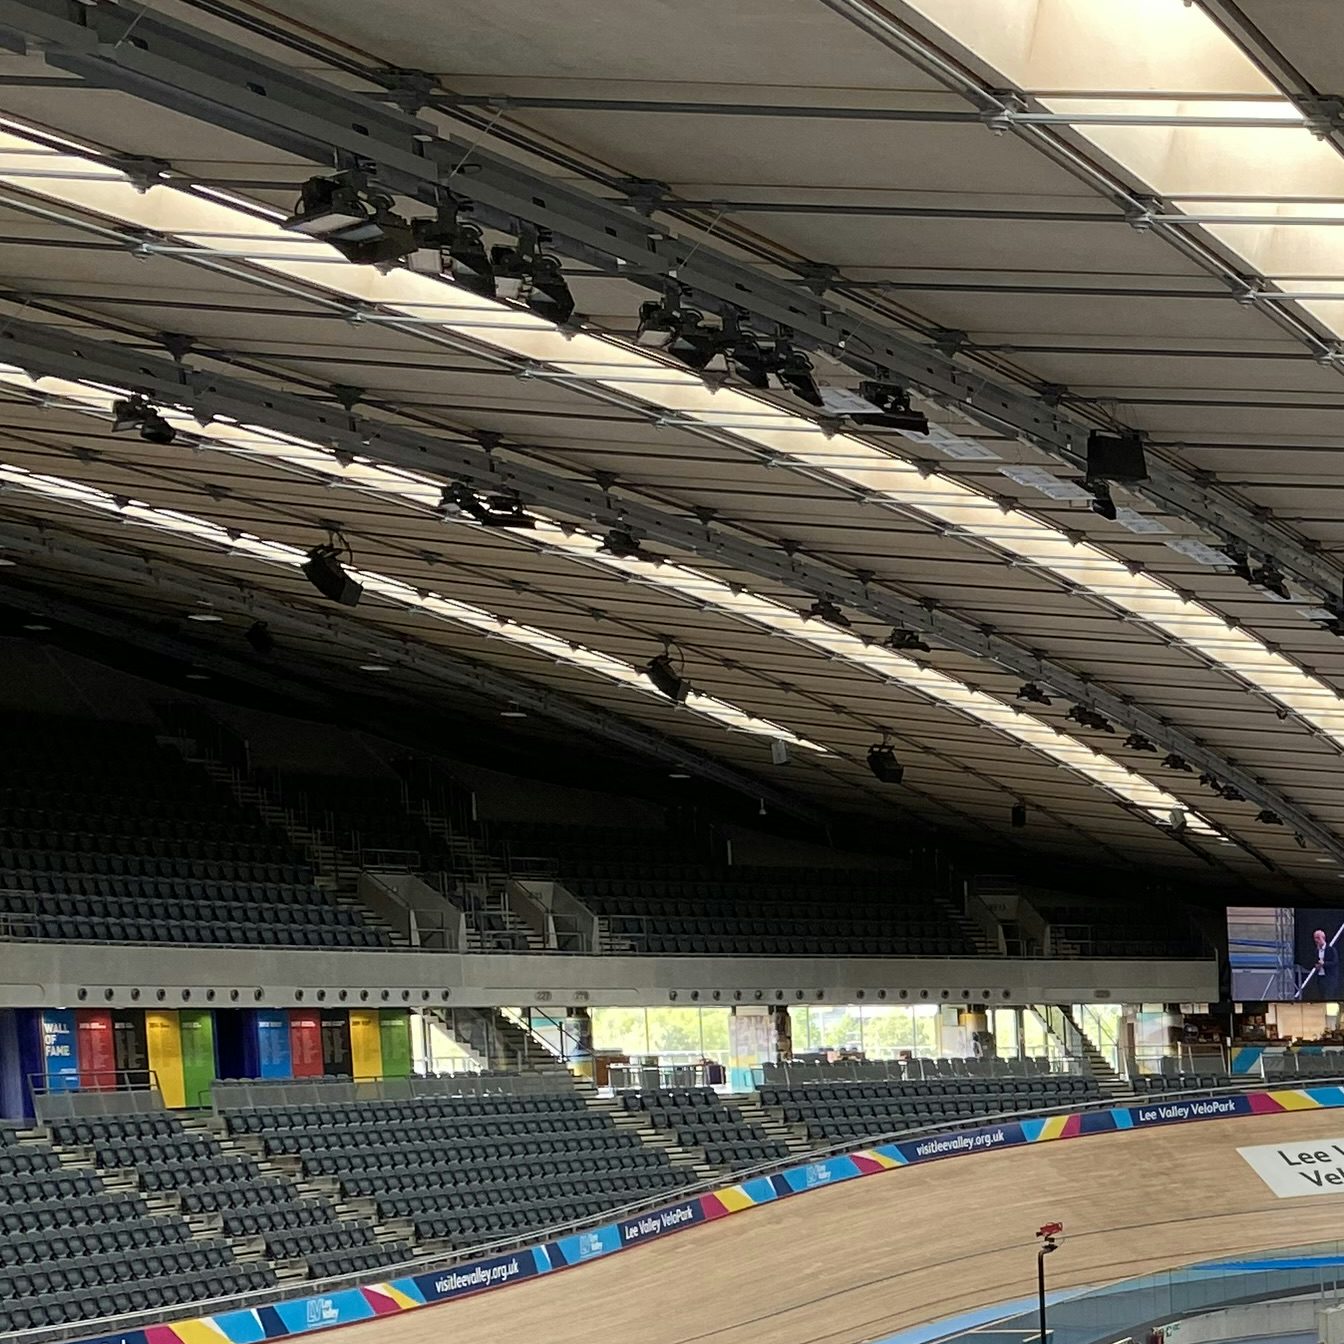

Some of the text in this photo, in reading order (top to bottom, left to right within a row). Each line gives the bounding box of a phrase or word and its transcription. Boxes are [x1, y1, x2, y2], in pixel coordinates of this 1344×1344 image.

[44, 1023, 70, 1034] WALL
[45, 1035, 57, 1045] OF
[45, 1046, 70, 1057] FAME
[1139, 1098, 1236, 1121] Lee Valley VeloPark
[916, 1129, 1005, 1157] visitleevalley.org.uk
[1277, 1148, 1332, 1167] Lee
[625, 1205, 693, 1240] Lee Valley VeloPark
[435, 1257, 519, 1294] visitleevalley.org.uk
